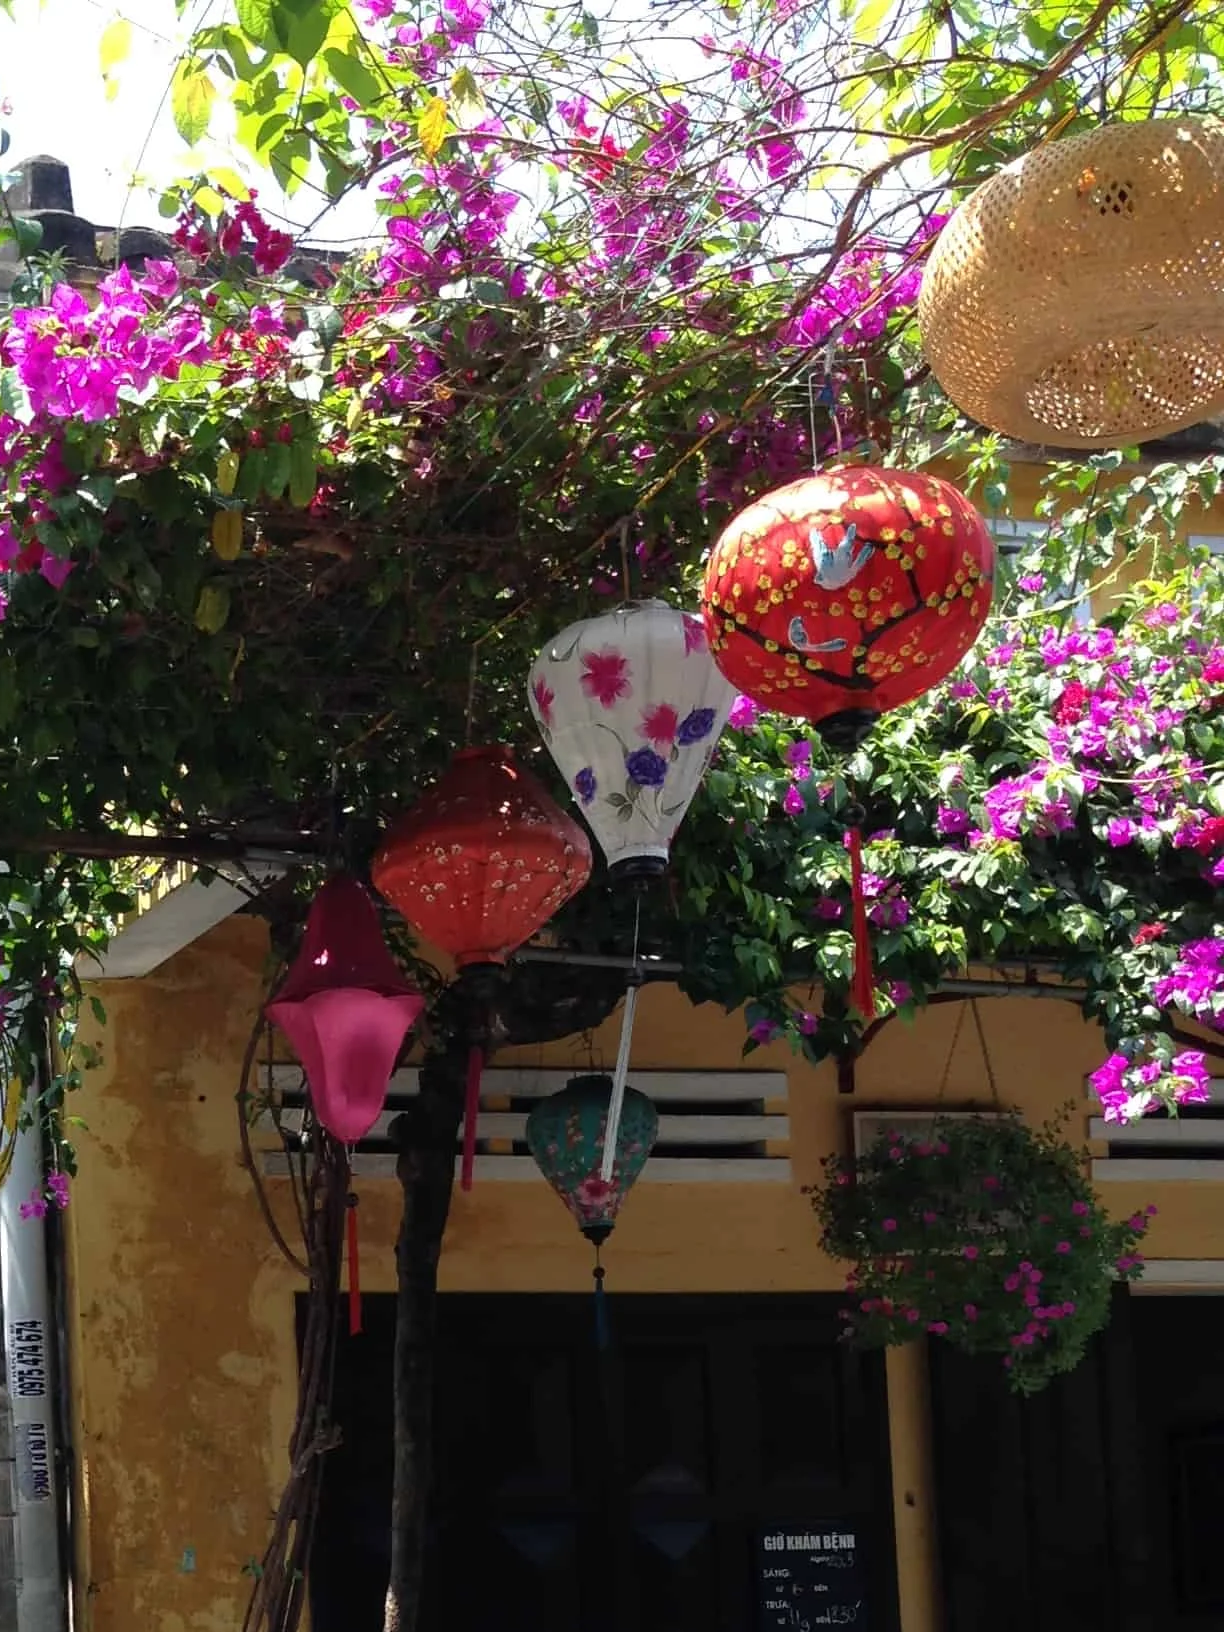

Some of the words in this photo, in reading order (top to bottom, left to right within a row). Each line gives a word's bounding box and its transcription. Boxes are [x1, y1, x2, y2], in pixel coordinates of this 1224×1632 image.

[15, 1320, 43, 1342] 674
[16, 1345, 43, 1366] 474
[17, 1369, 45, 1396] 0975
[763, 1531, 785, 1551] GIỜ
[786, 1531, 821, 1551] KHÁM
[823, 1531, 856, 1552] BỆNH
